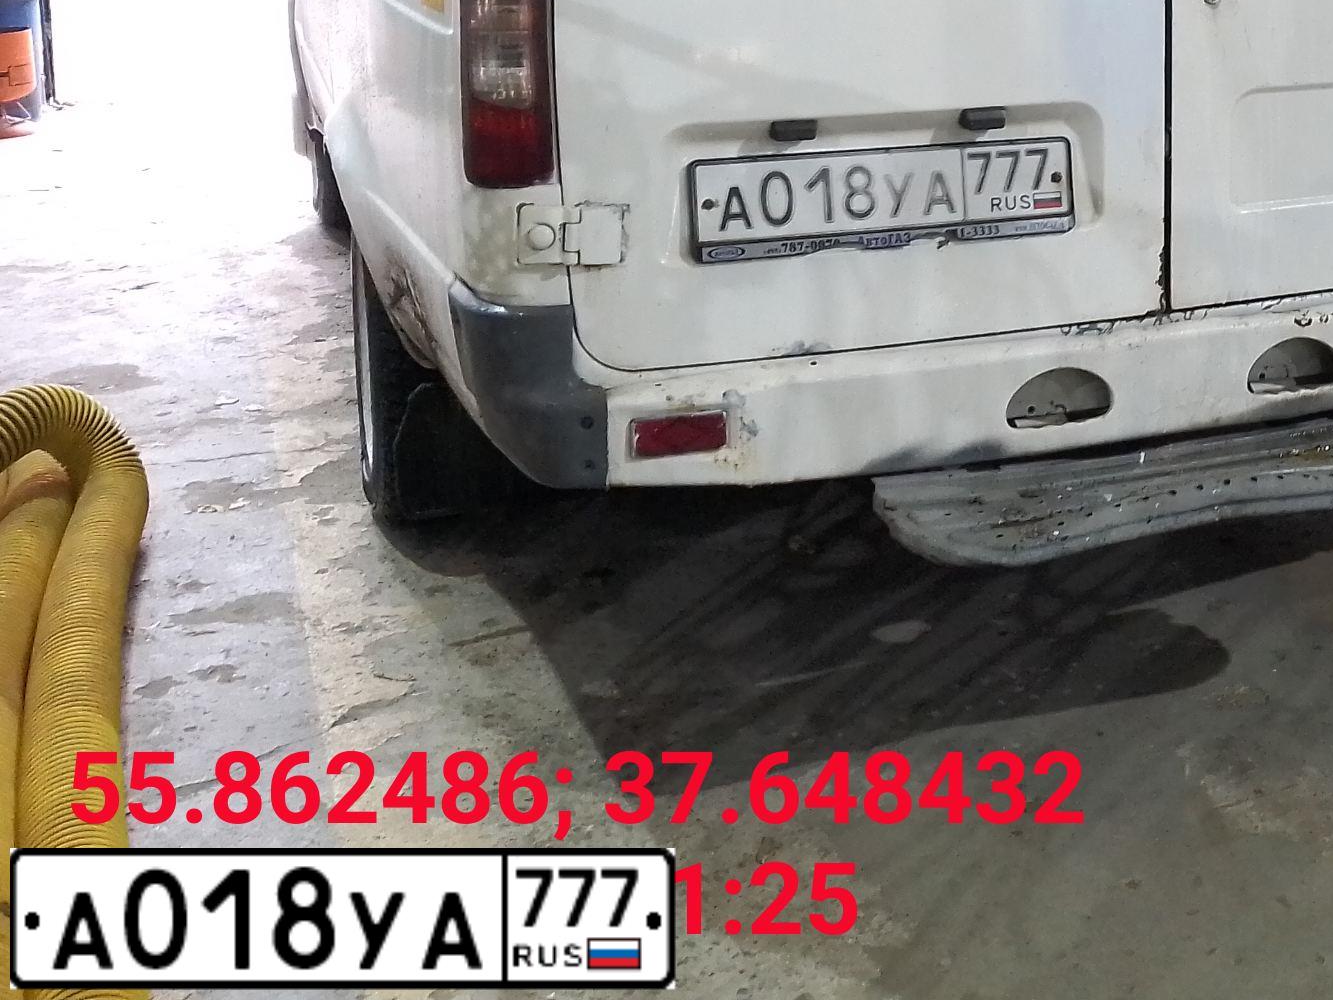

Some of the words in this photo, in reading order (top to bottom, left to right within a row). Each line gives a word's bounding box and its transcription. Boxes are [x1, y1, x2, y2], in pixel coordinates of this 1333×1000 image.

[719, 165, 957, 232] А018УА
[967, 148, 1049, 195] 777
[990, 194, 1032, 213] RUS
